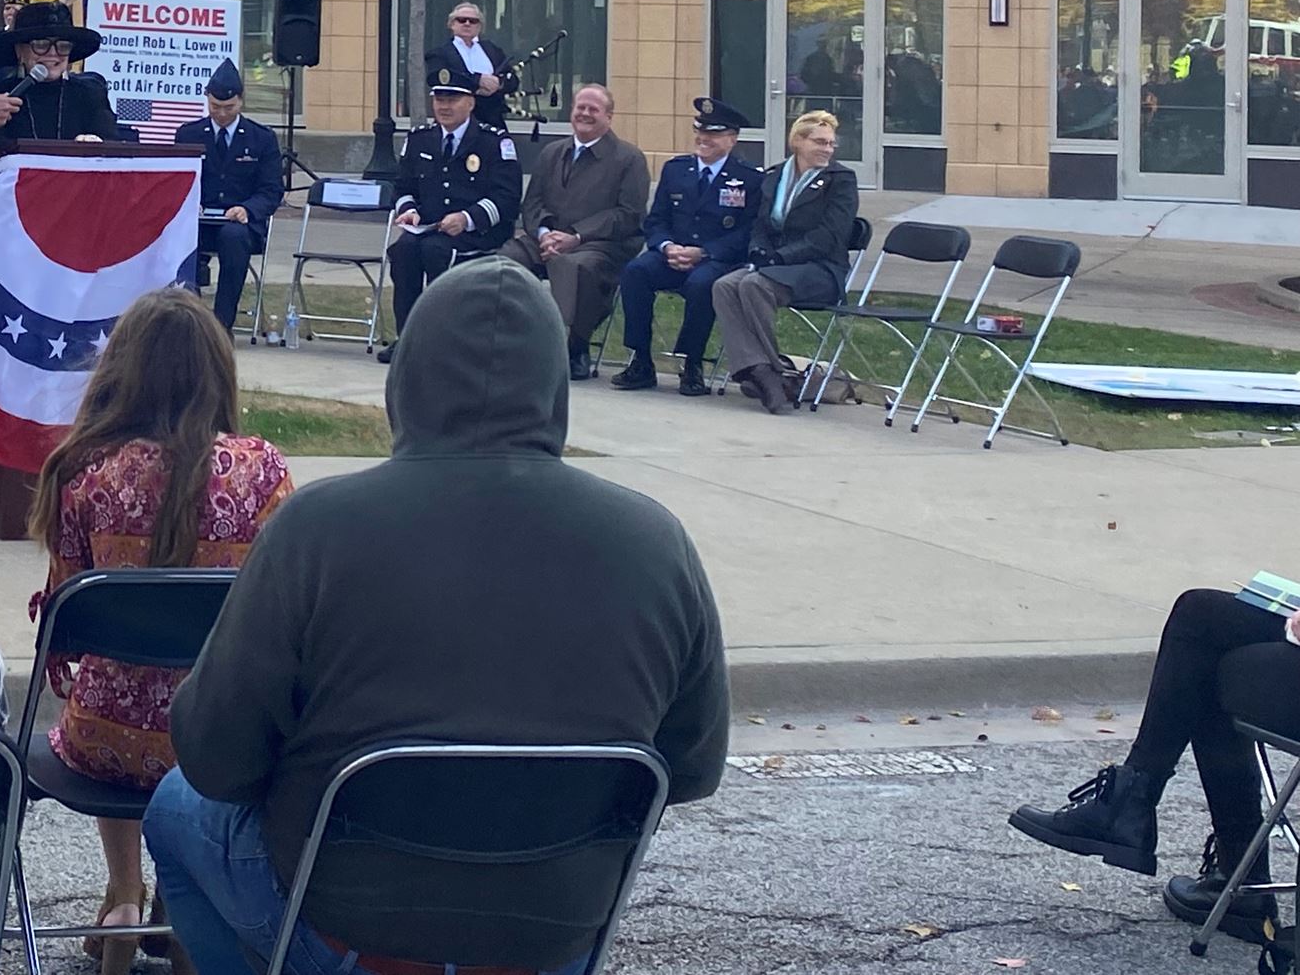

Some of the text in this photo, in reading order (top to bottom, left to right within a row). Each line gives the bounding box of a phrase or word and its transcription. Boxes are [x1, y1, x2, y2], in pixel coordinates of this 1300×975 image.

[104, 2, 225, 27] WELCOME
[100, 34, 139, 47] olonel
[143, 36, 166, 49] Rob
[185, 38, 216, 53] Lowe
[220, 40, 233, 53] III
[112, 59, 212, 78] & Friends From
[106, 79, 131, 92] cott
[135, 79, 153, 93] Air
[157, 80, 192, 95] Force
